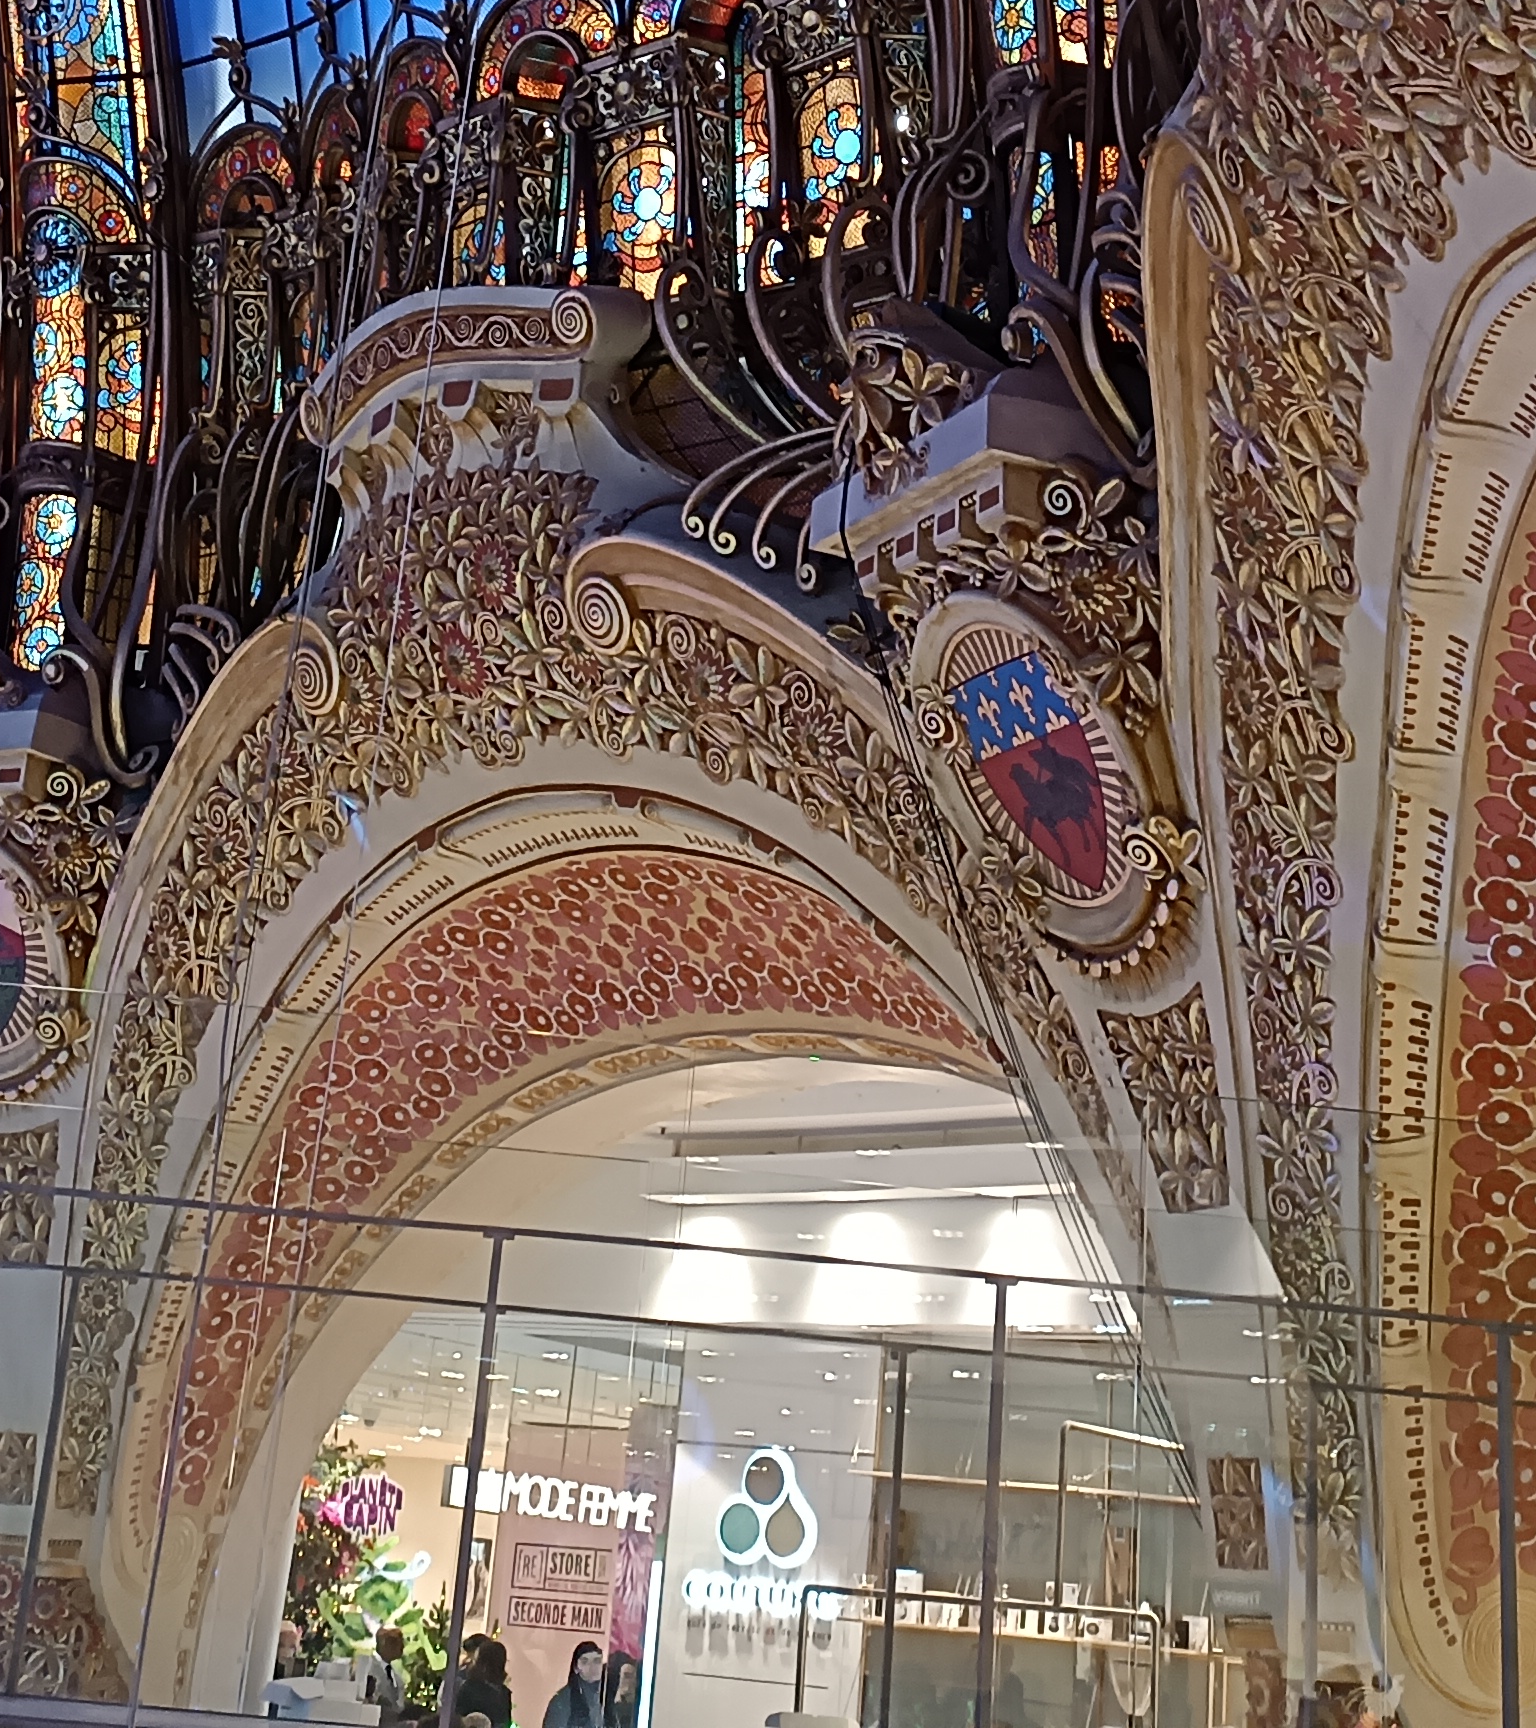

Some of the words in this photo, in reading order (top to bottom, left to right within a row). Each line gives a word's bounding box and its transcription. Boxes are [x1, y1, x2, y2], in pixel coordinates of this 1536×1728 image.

[501, 1471, 579, 1522] MODE
[578, 1483, 658, 1534] FEMME
[549, 1551, 592, 1578] STORE
[512, 1600, 567, 1627] SECONDE
[570, 1604, 604, 1630] MAIN
